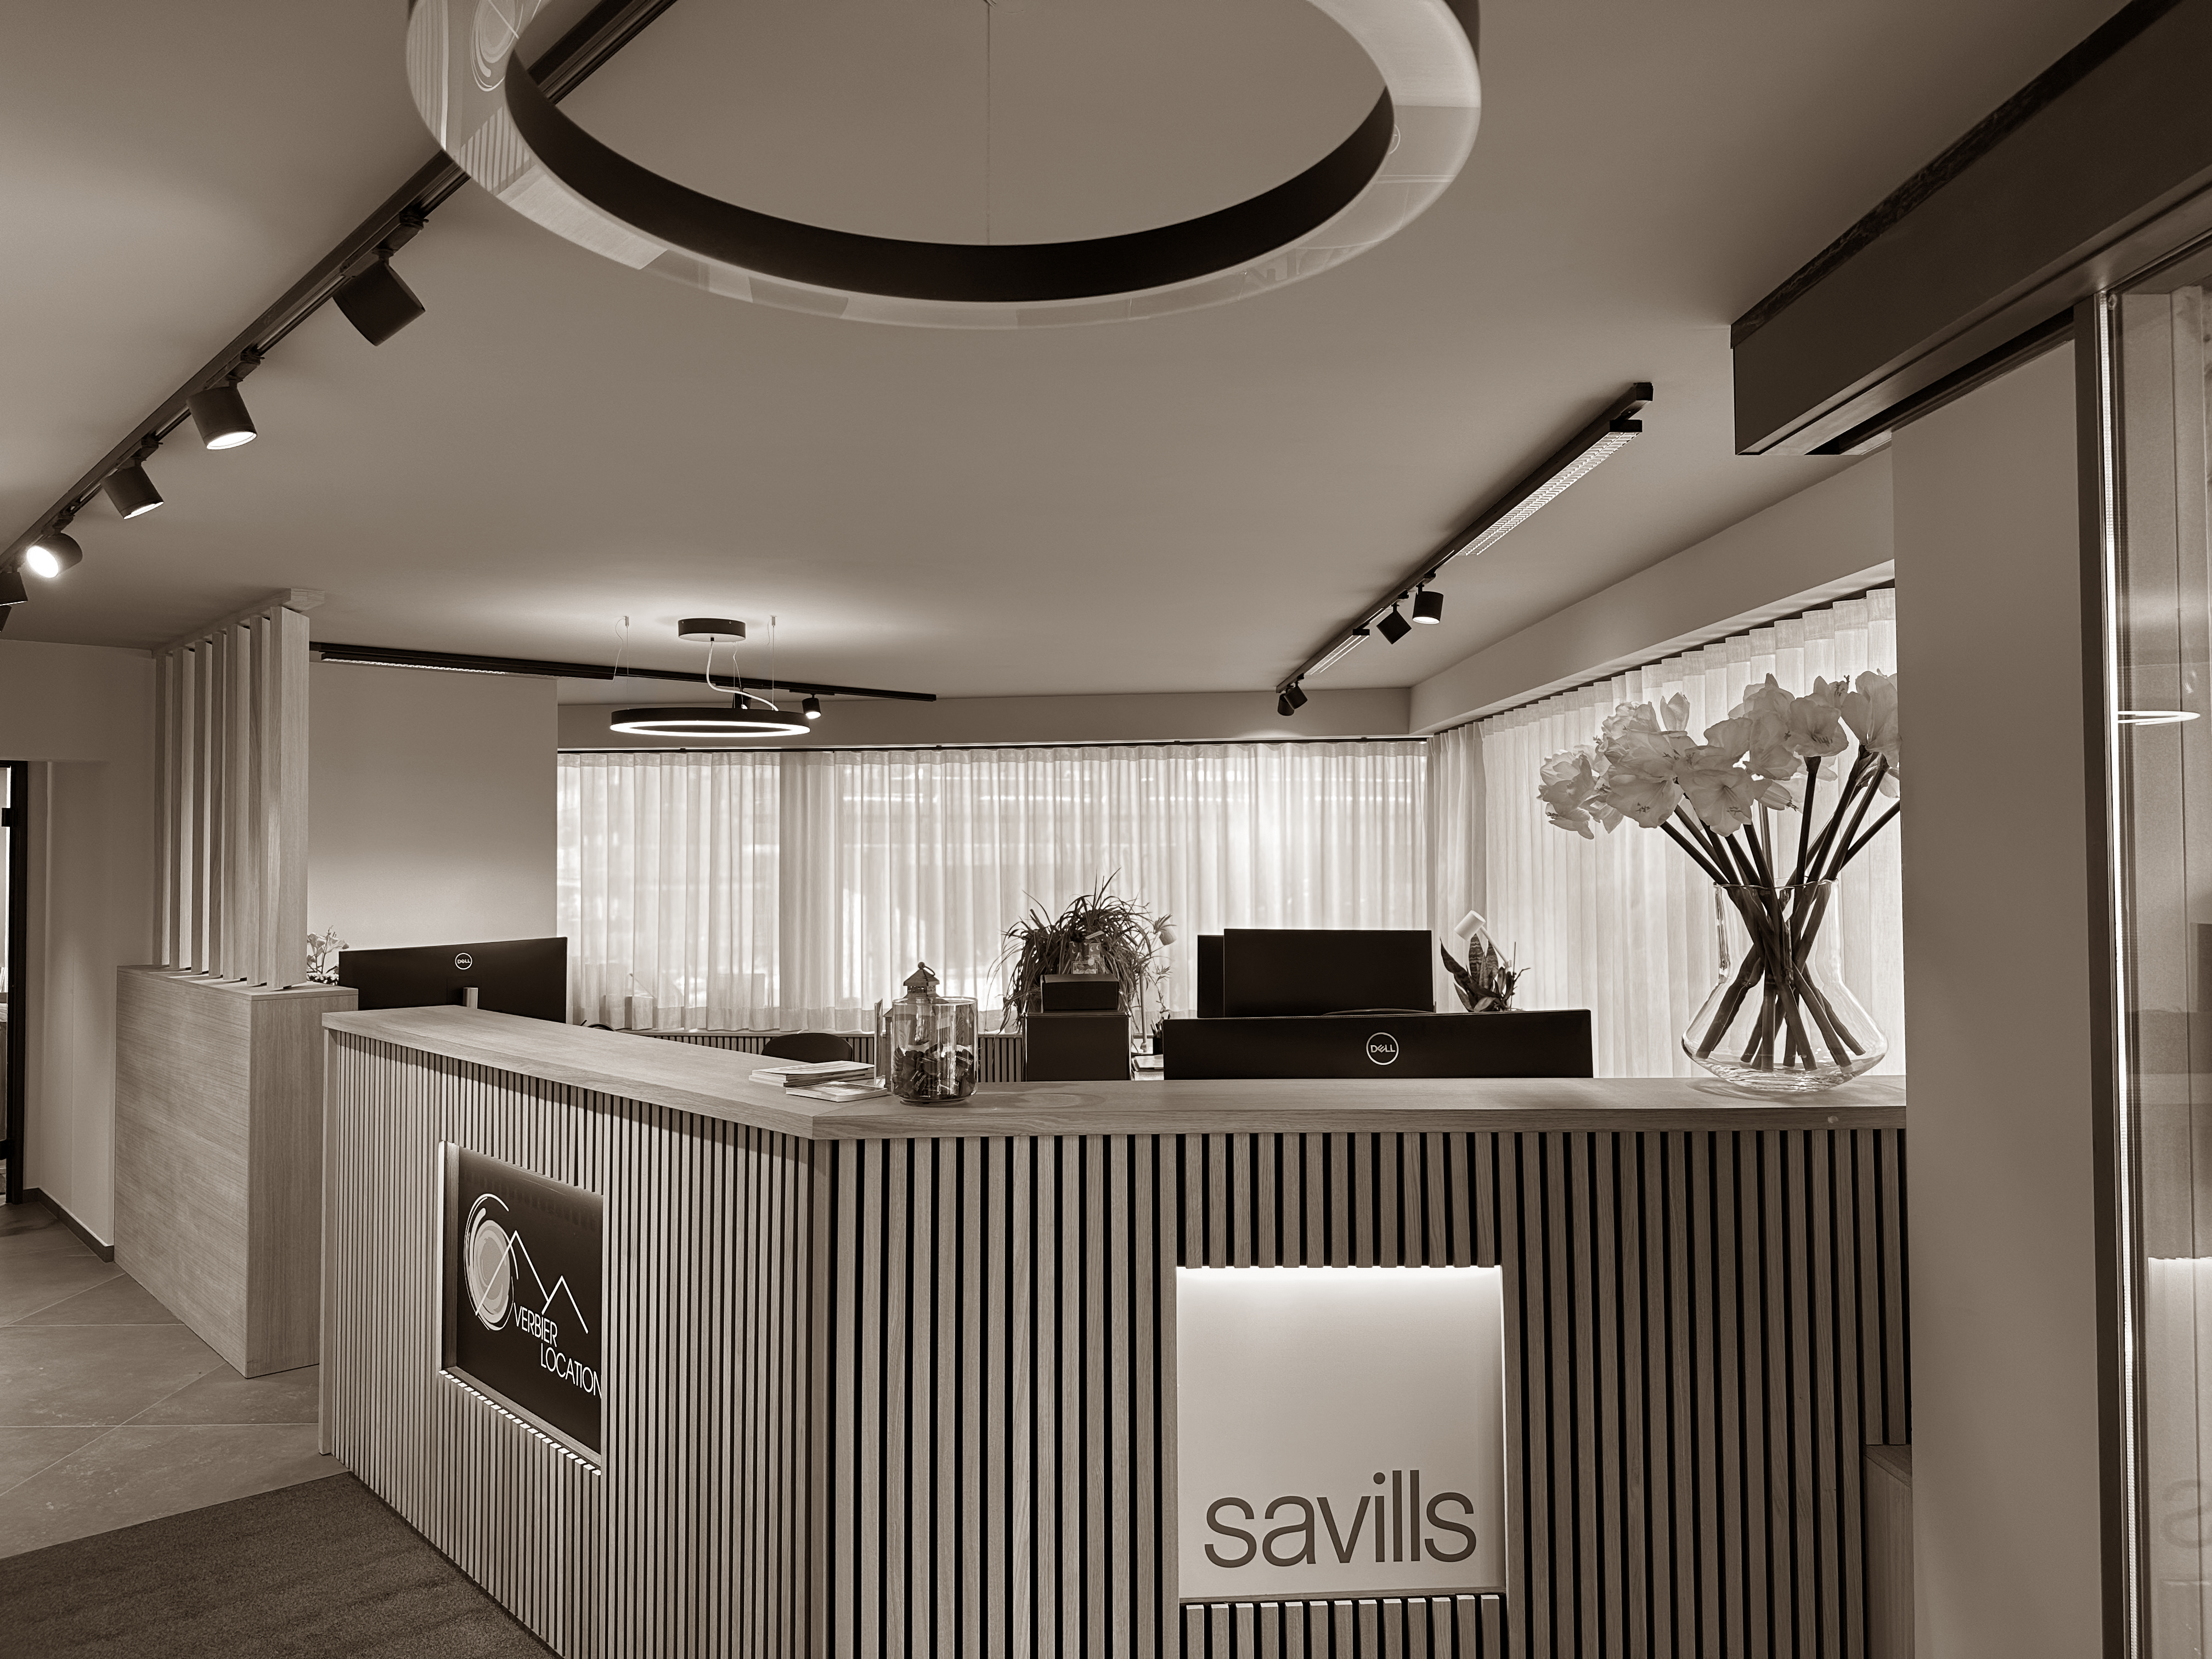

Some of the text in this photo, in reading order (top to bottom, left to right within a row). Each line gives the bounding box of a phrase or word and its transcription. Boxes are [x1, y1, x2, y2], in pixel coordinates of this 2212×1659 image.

[1370, 1044, 1396, 1053] DELL
[514, 1302, 558, 1347] VERBIER
[540, 1342, 602, 1400] LOCATION
[1204, 1469, 1476, 1568] savills
